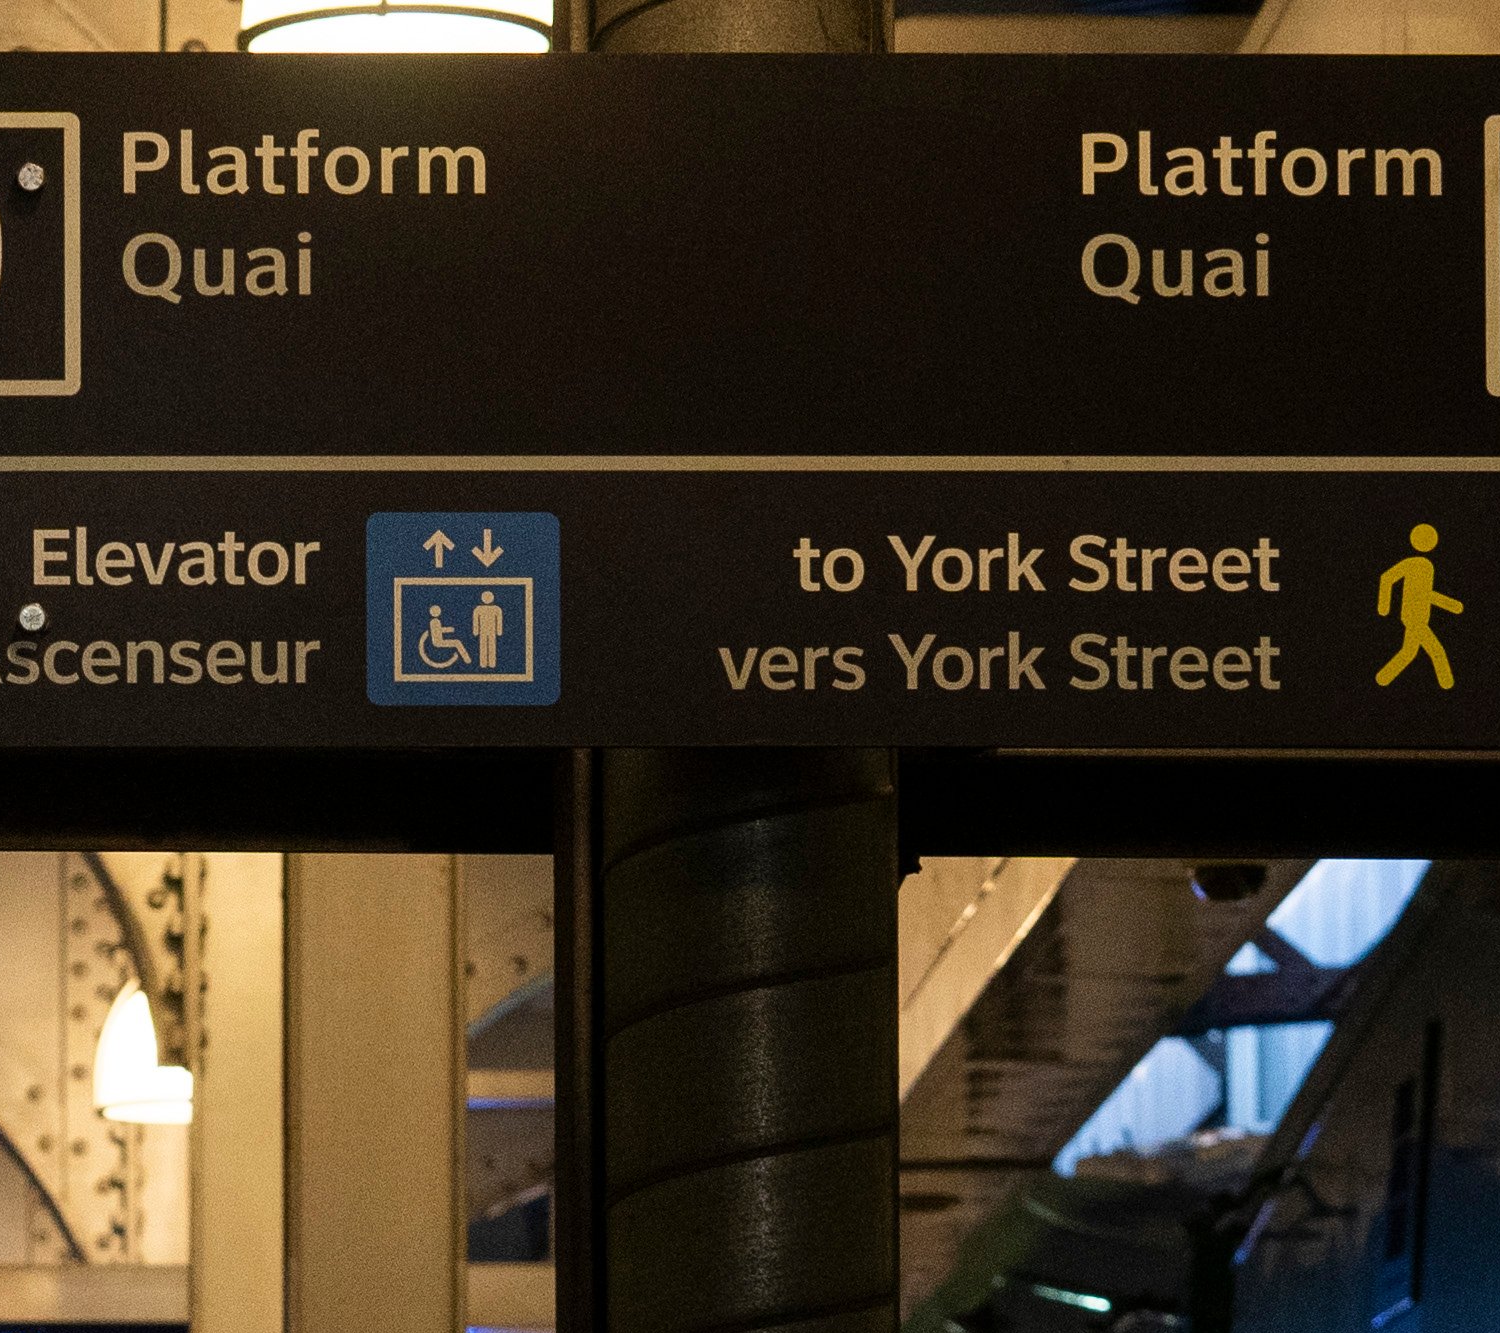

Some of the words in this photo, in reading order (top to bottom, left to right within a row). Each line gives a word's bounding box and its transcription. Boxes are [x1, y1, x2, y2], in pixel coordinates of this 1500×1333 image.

[122, 128, 487, 196] Platform
[1080, 129, 1444, 198] Platform
[120, 231, 314, 305] Quai
[1079, 231, 1271, 306] Quai
[32, 526, 323, 587] Elevator
[791, 536, 866, 593] to
[886, 531, 1047, 593] York
[1067, 533, 1281, 593] Street
[717, 646, 867, 692] vers
[887, 630, 1047, 692] York
[1068, 631, 1282, 692] Street
